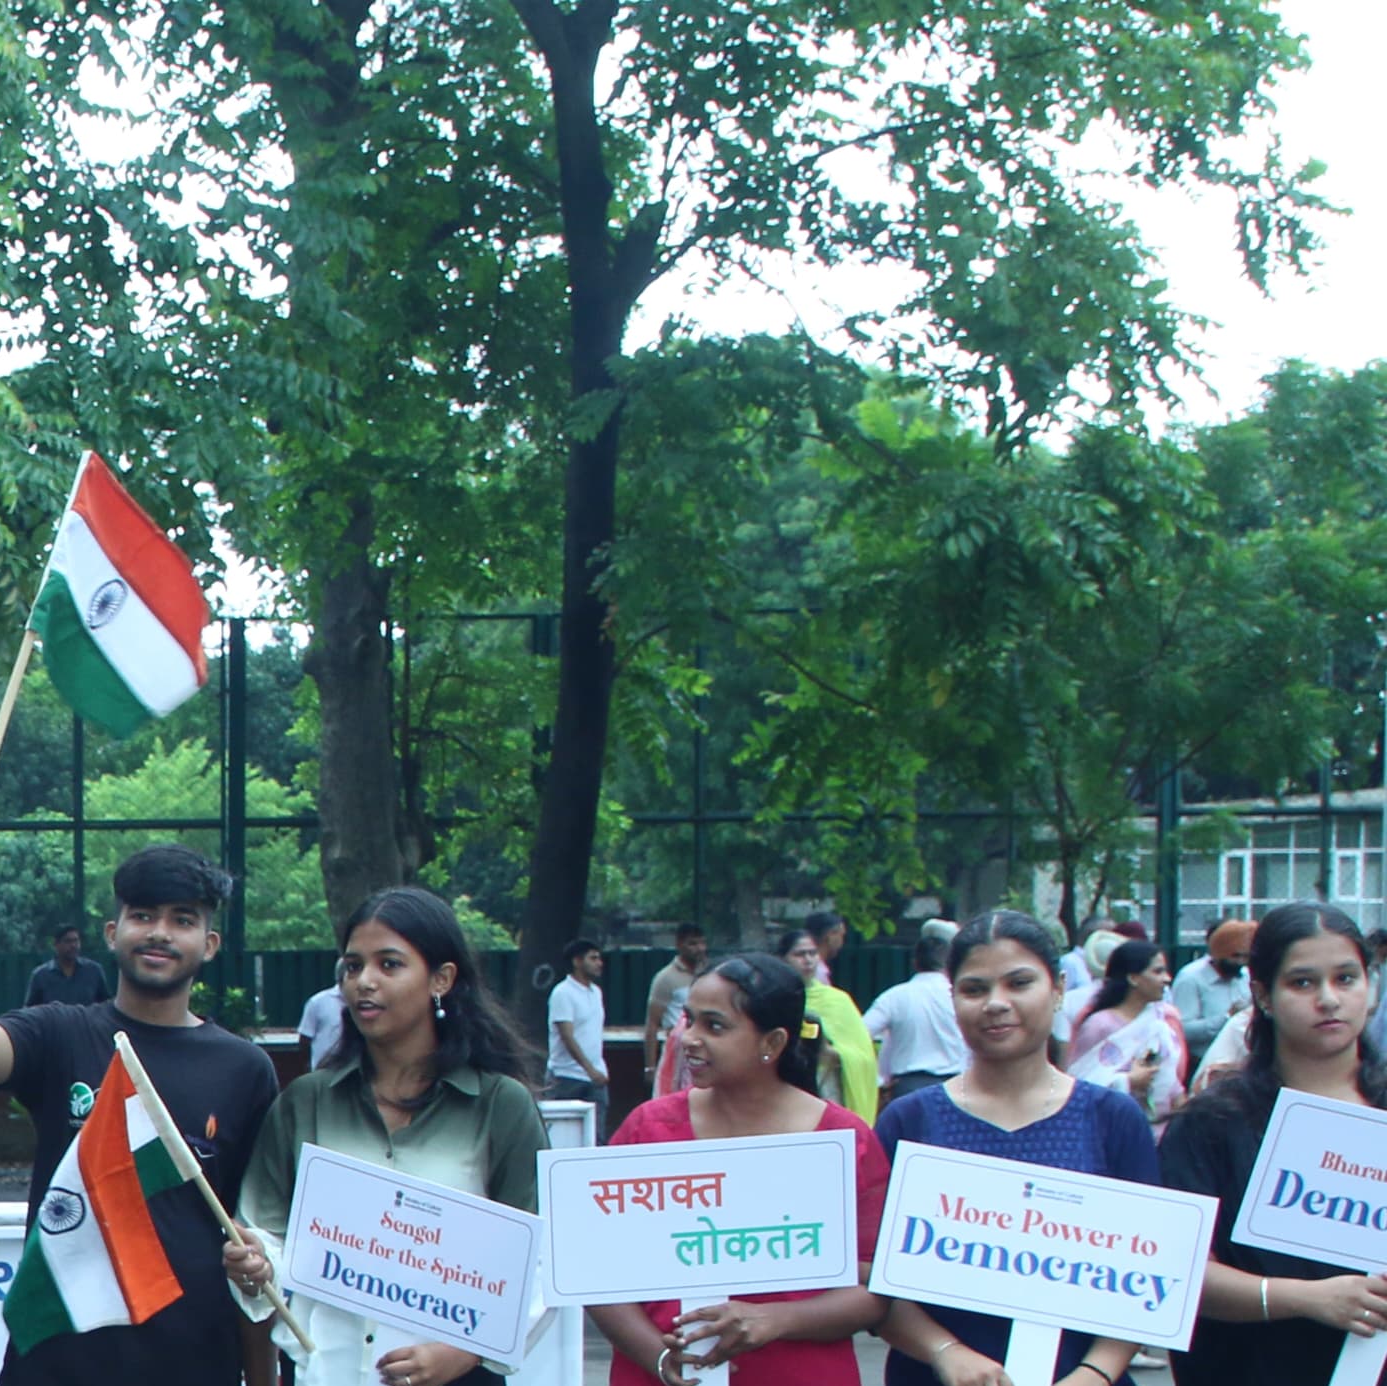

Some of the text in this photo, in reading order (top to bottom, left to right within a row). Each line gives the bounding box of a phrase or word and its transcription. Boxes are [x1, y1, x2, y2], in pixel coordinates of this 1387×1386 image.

[589, 1172, 726, 1215] सशक्त
[935, 1193, 1013, 1230] More
[1021, 1209, 1122, 1250] Power
[1130, 1233, 1158, 1257] to
[309, 1217, 507, 1297] Salute for the Spirit of
[380, 1211, 442, 1245] Sengol
[671, 1214, 823, 1266] लोकतंत्र
[321, 1250, 486, 1335] Democracy
[900, 1215, 1182, 1312] Democracy
